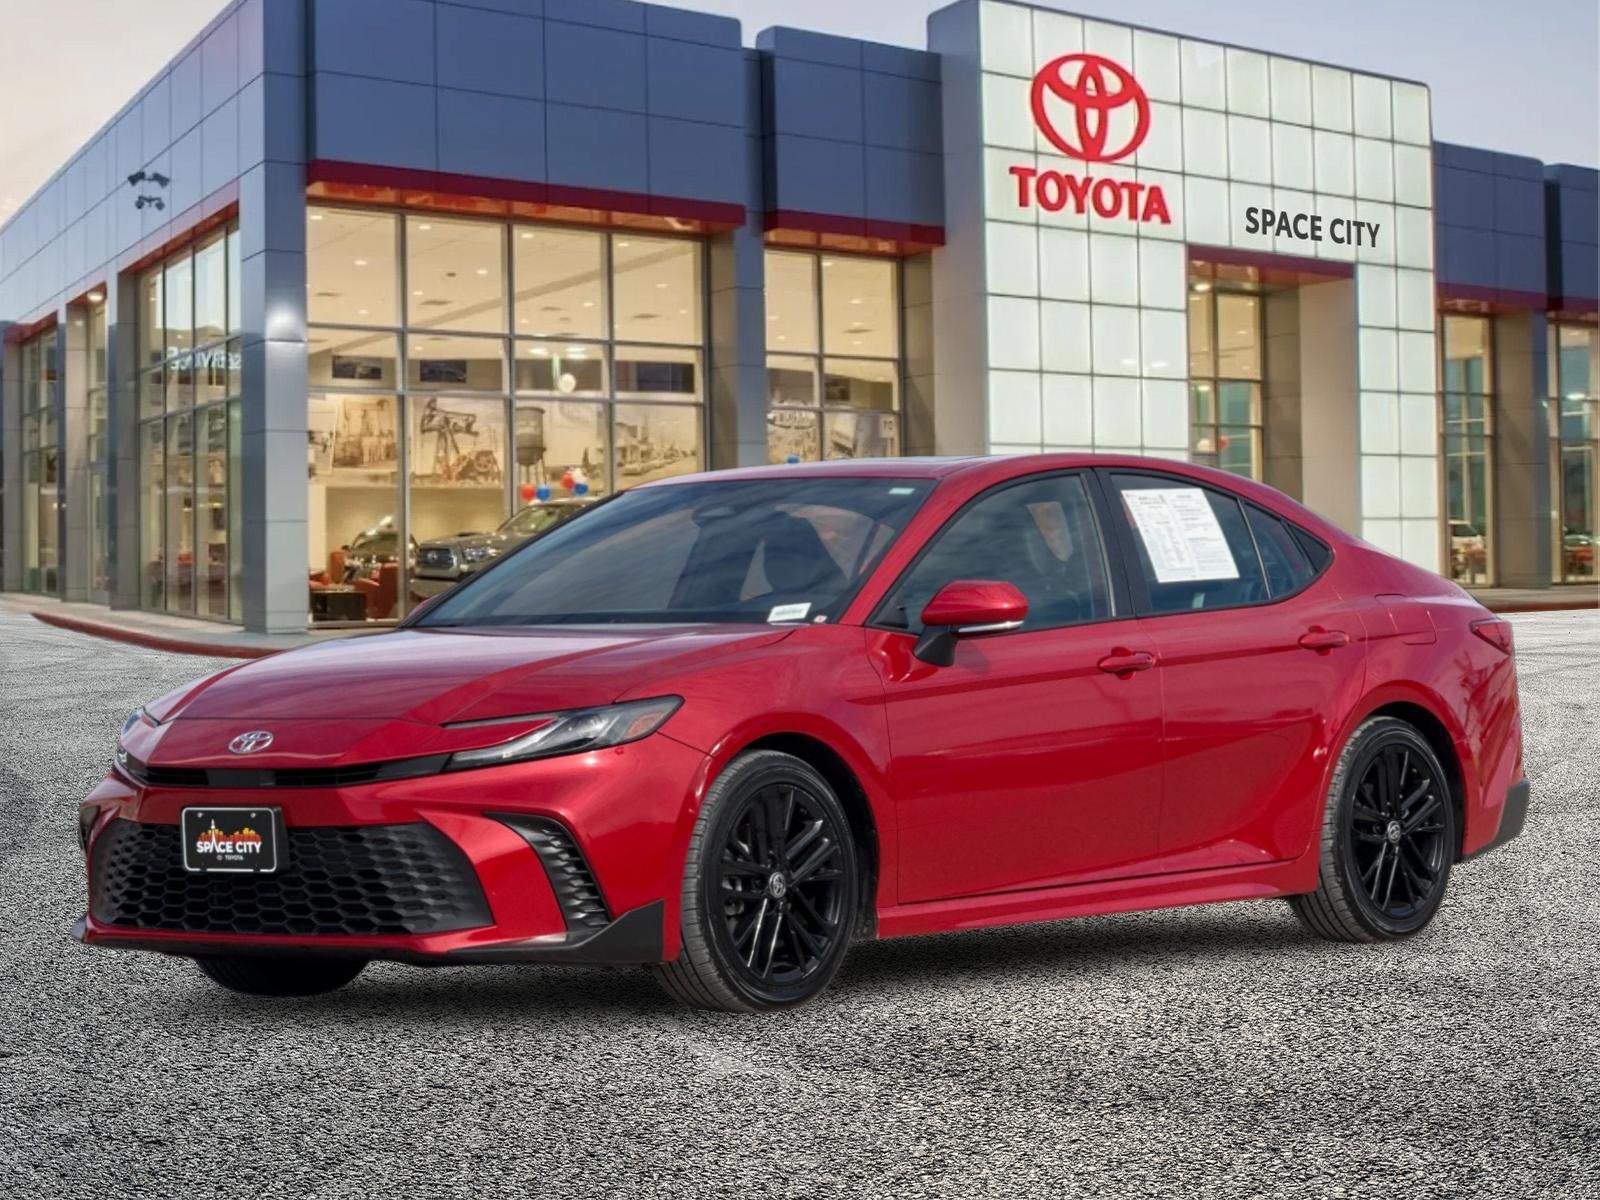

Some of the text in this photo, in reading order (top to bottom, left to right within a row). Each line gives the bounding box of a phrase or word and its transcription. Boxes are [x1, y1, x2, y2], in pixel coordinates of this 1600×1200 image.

[1009, 166, 1171, 224] TOYOTA
[1245, 206, 1380, 248] SPACE CITY
[196, 840, 262, 853] SPACE CITY
